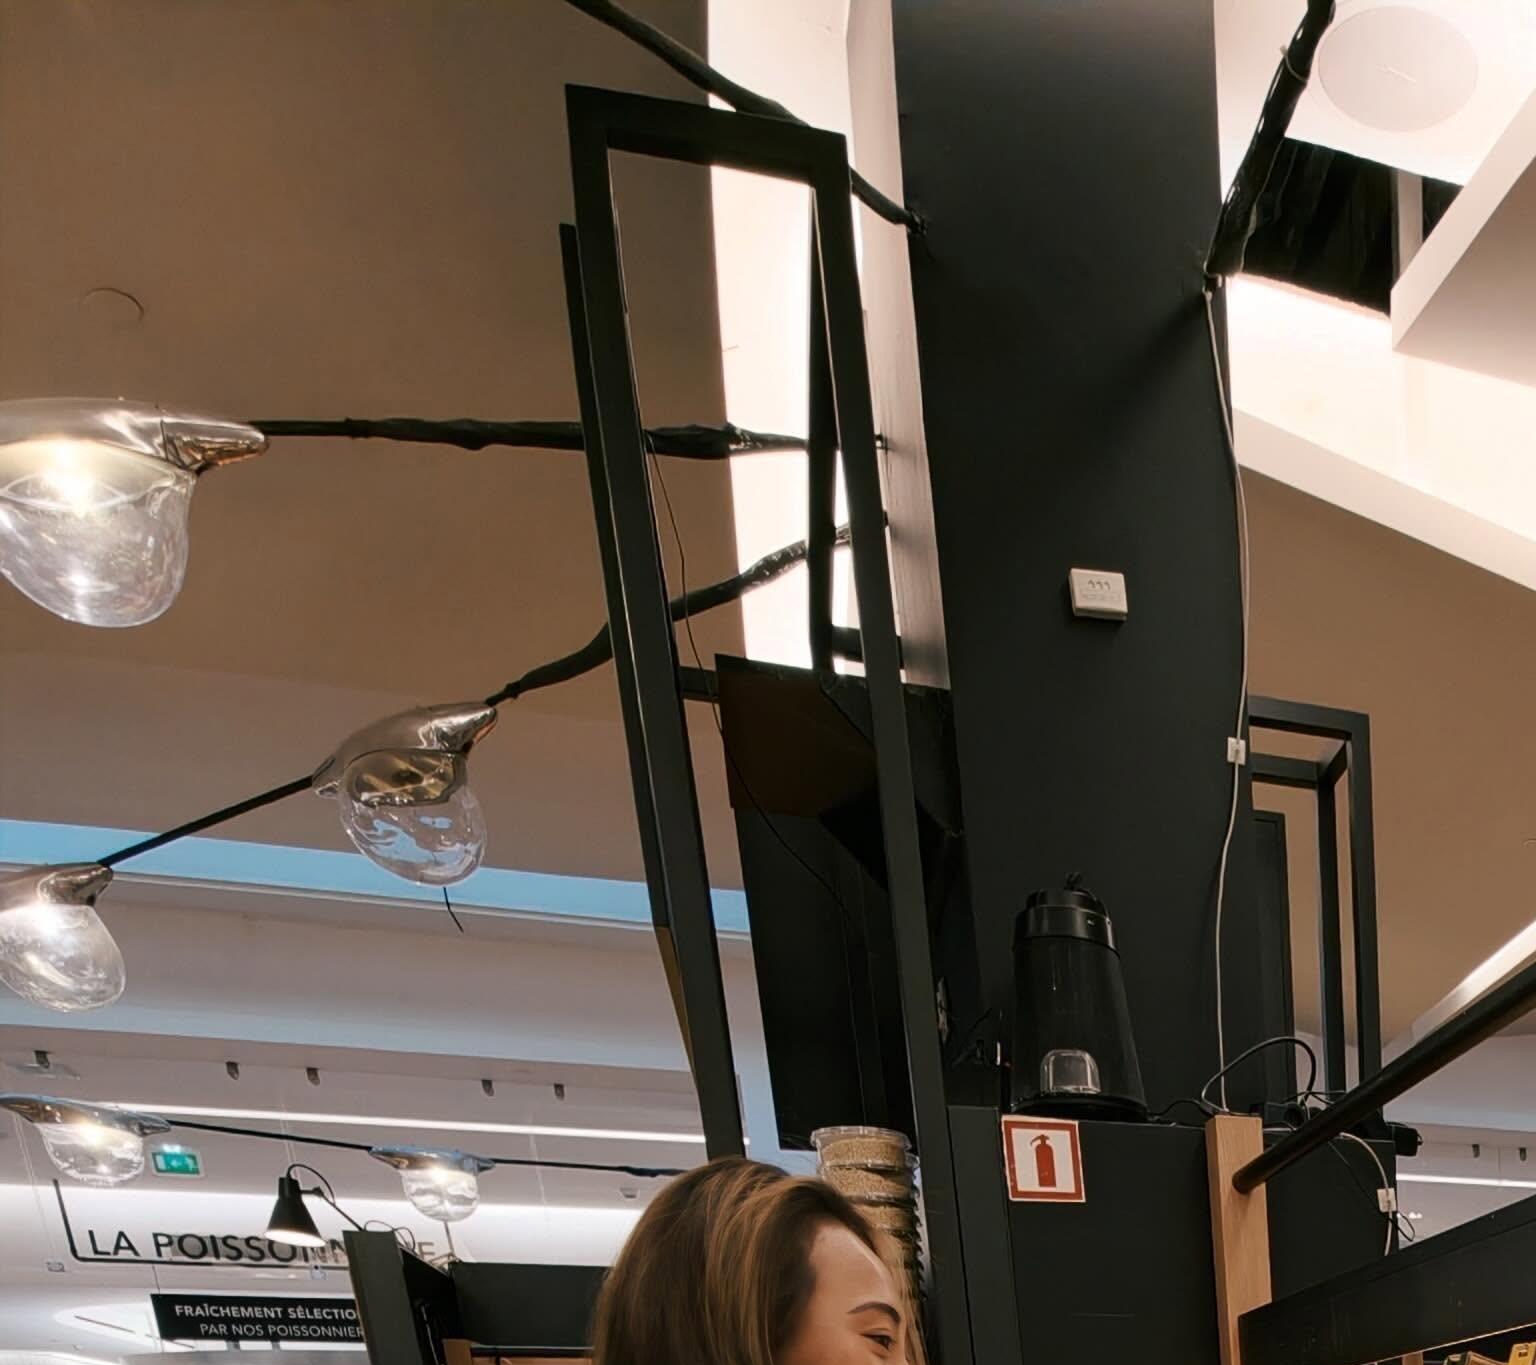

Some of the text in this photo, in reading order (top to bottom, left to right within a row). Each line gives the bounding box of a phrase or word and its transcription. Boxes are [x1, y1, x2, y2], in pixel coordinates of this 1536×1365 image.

[88, 1229, 140, 1257] LA
[175, 1303, 357, 1320] FRAÎCHEMENT SÉLECTIO
[200, 1323, 228, 1336] PAR
[232, 1324, 264, 1337] NOS
